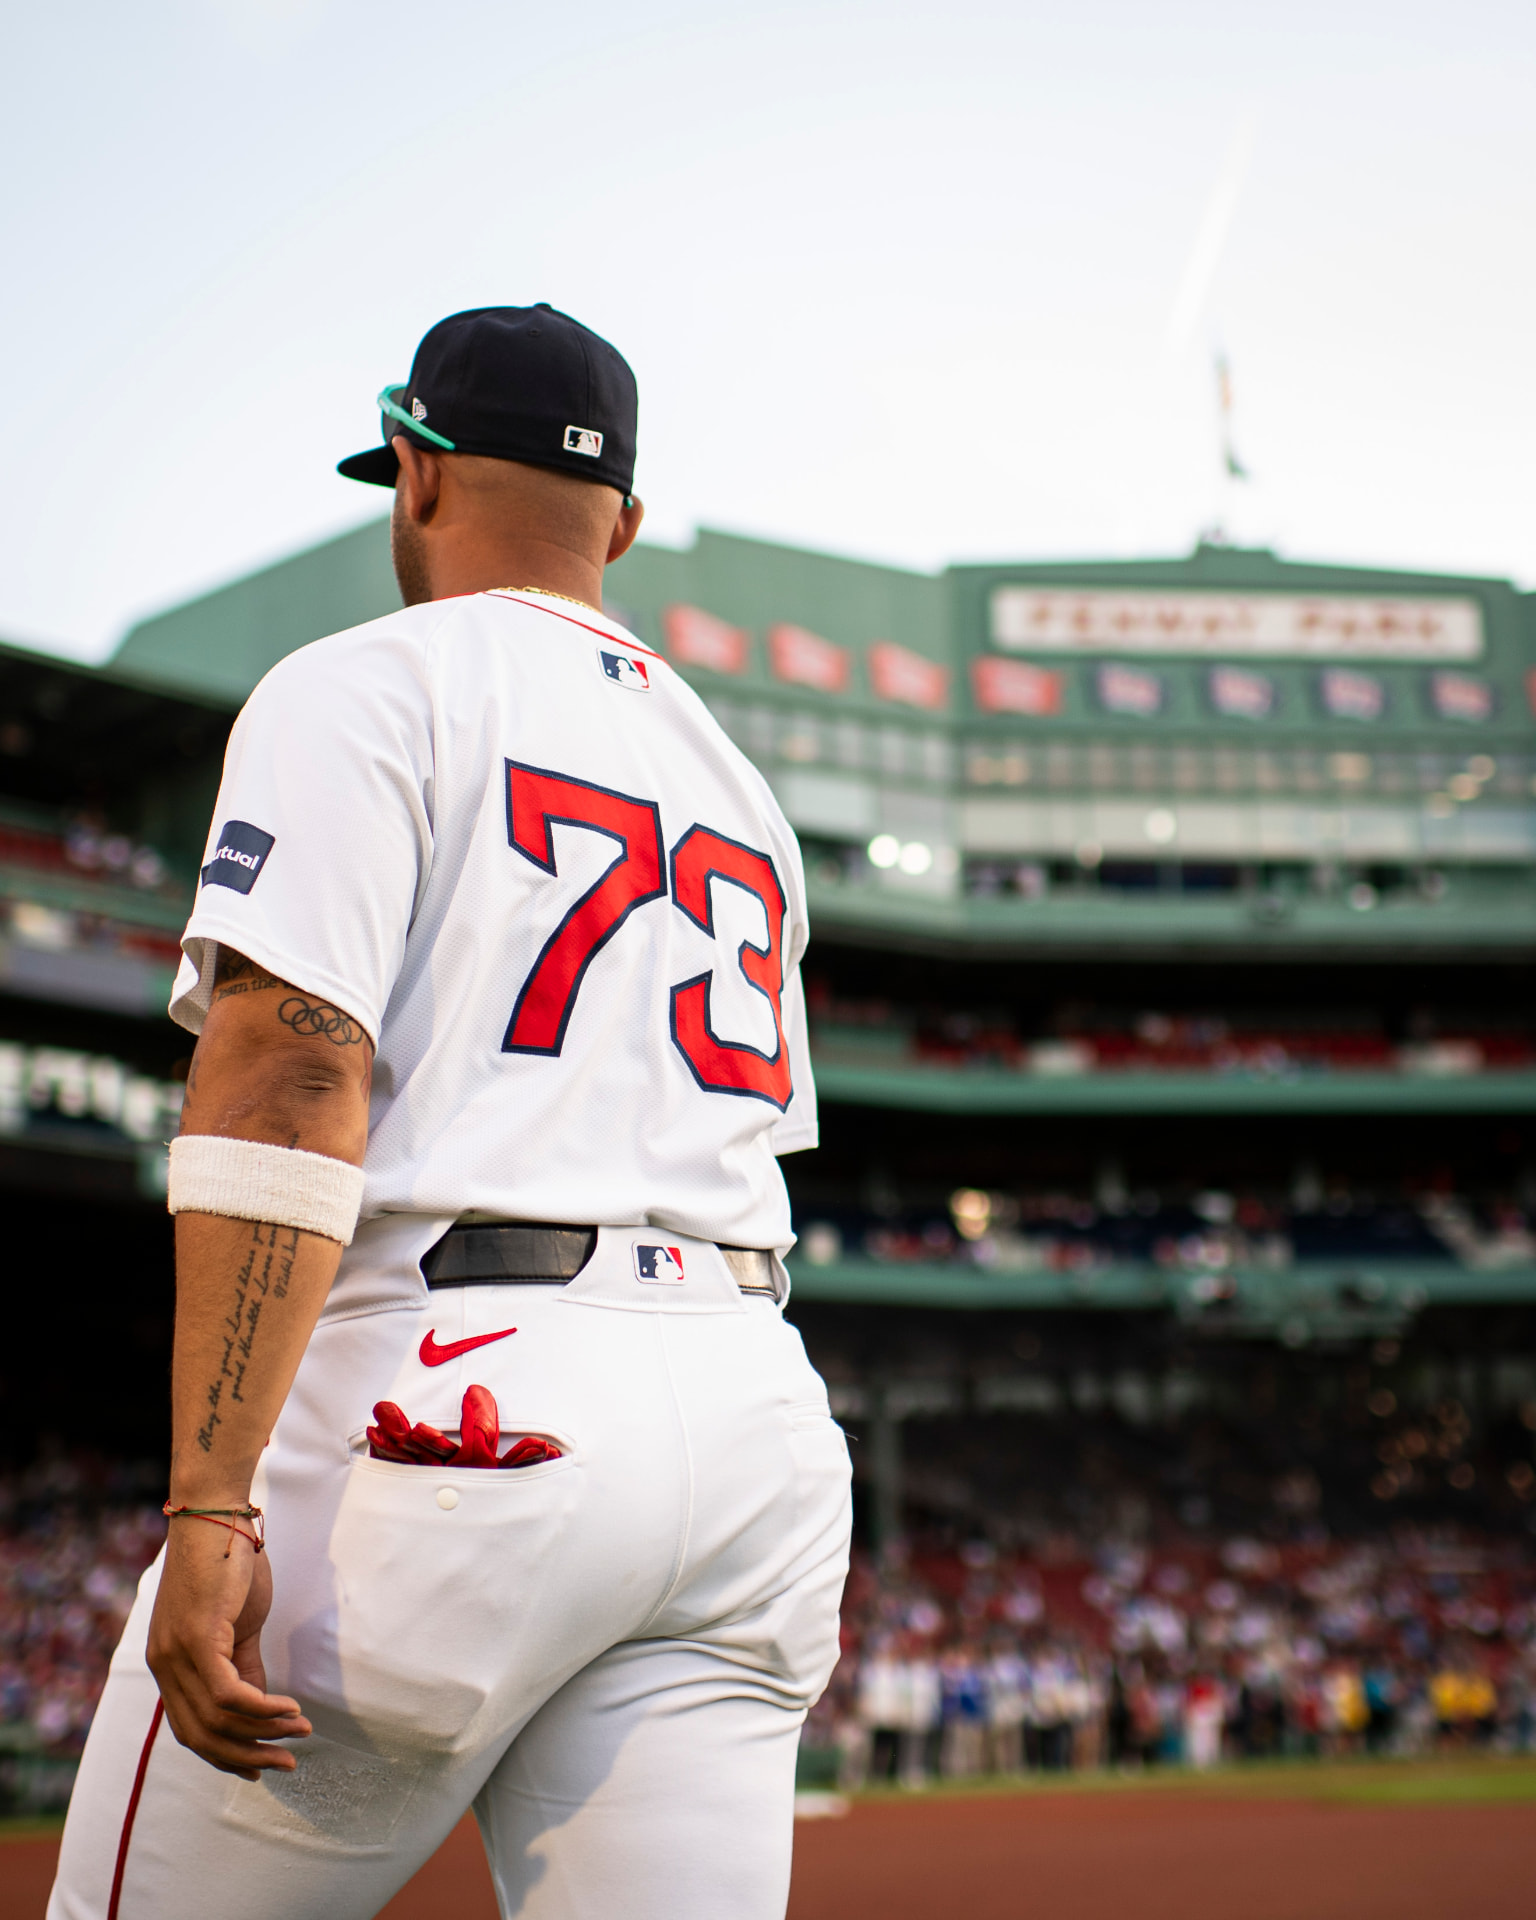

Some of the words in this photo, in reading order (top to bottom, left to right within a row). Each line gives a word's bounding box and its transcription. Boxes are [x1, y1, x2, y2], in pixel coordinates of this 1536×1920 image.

[501, 757, 794, 1113] 73
[208, 1380, 222, 1409] the
[222, 1336, 235, 1376] good
[232, 1360, 246, 1402] good
